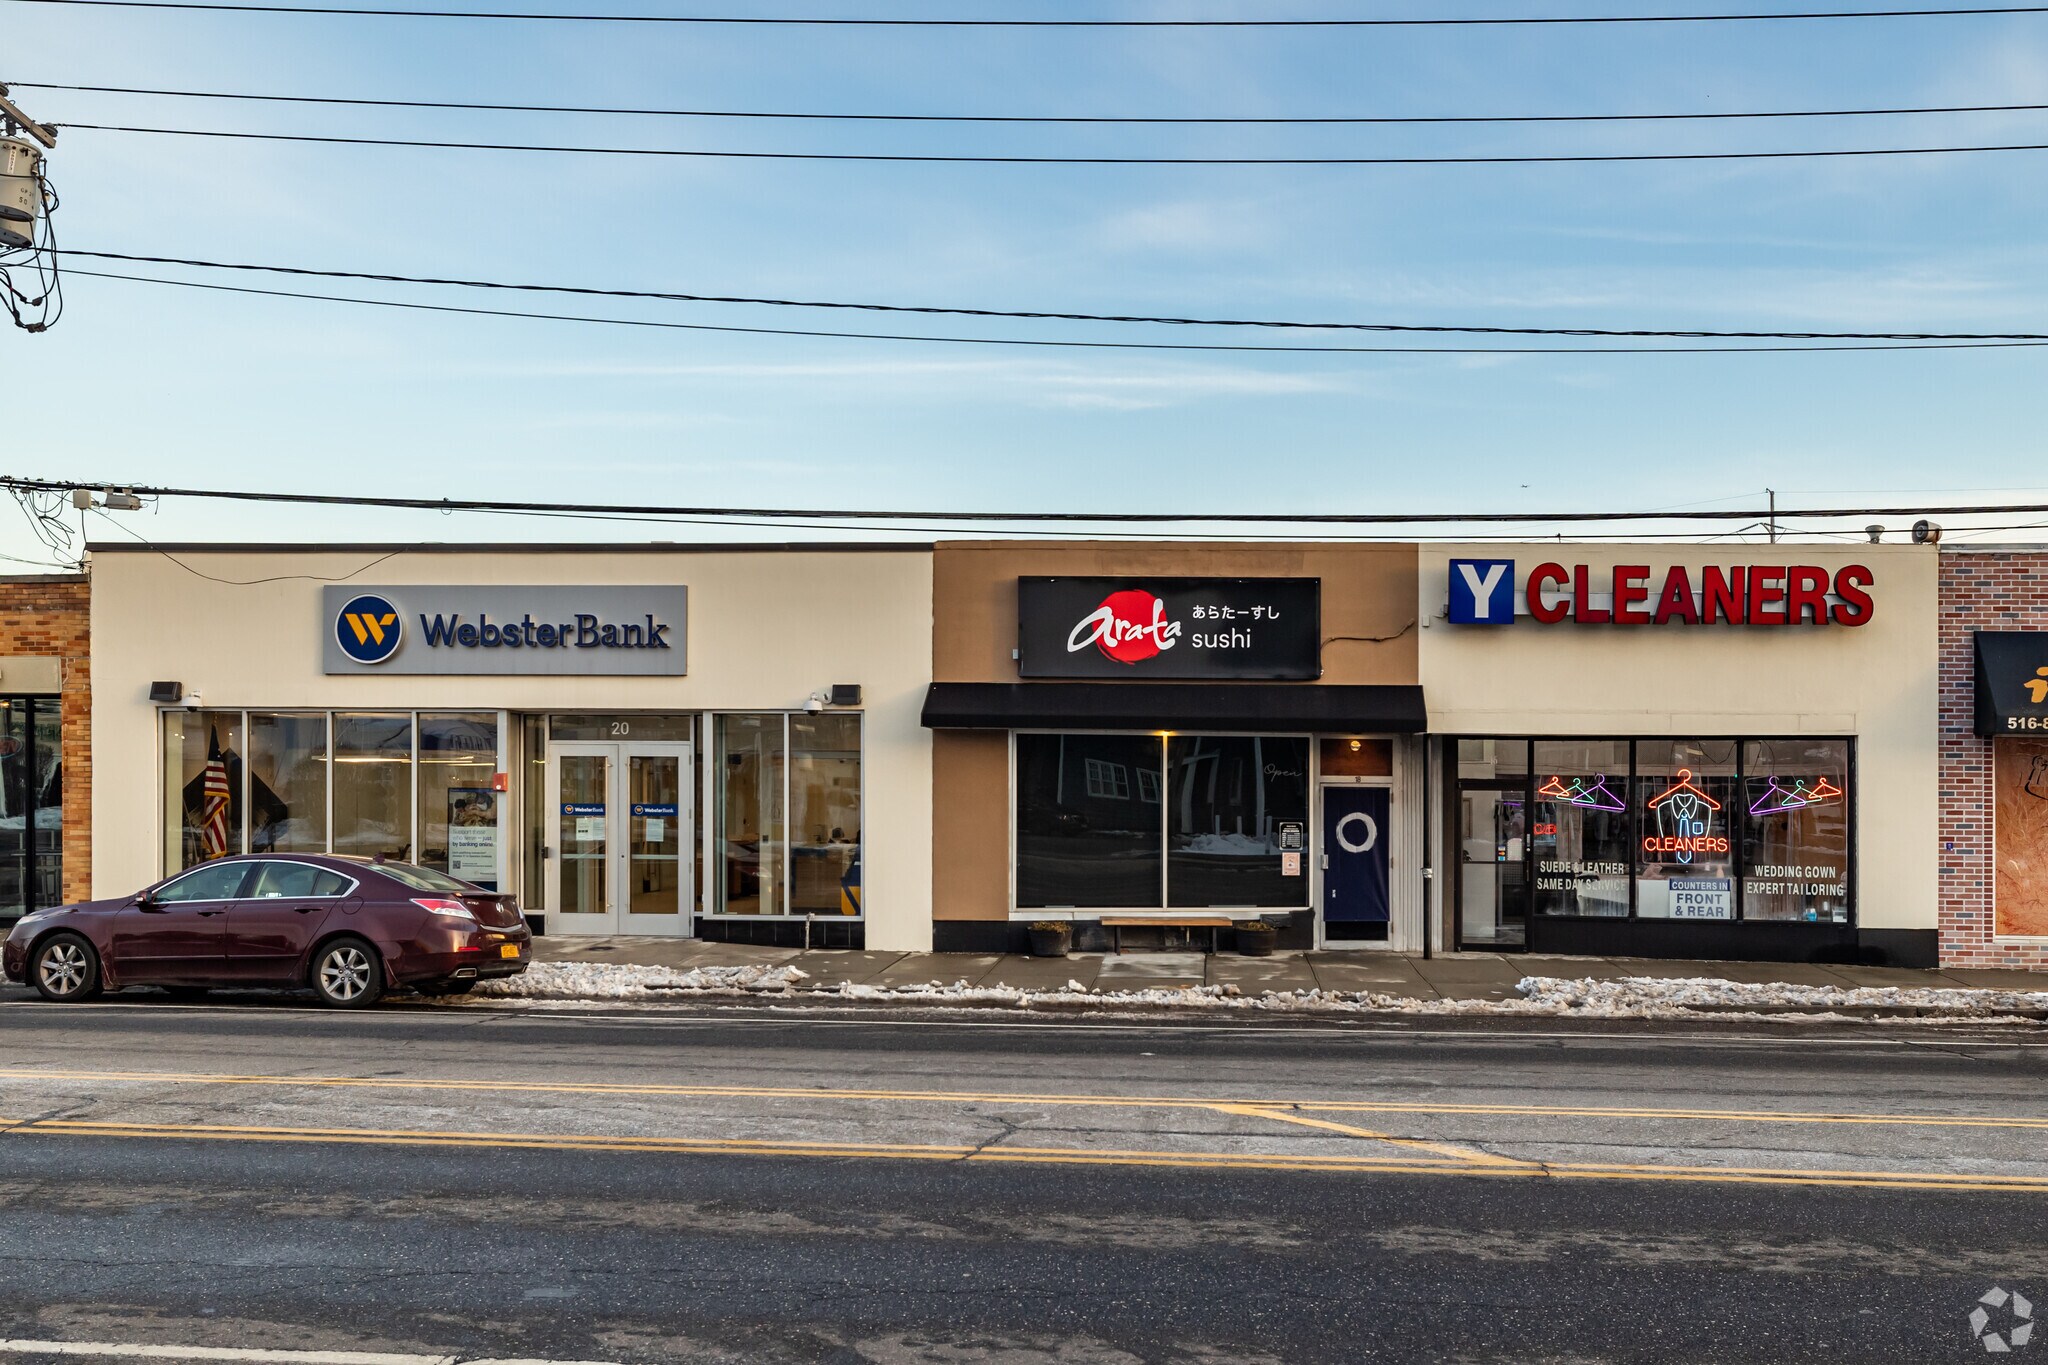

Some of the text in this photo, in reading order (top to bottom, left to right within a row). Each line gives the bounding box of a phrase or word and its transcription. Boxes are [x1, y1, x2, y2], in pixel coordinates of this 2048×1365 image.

[1457, 562, 1875, 627] Y CLEANERS
[1192, 605, 1280, 620] あらたーすし
[419, 613, 671, 649] WebsterBank
[1191, 628, 1251, 649] sushi
[611, 721, 629, 735] 20
[1264, 763, 1302, 782] Open
[1643, 837, 1729, 852] CLEANERS
[1540, 860, 1625, 875] SUEDE & LEATHER
[1754, 865, 1836, 879] WEDDING GOWN
[1537, 878, 1564, 890] SAME
[1565, 878, 1584, 890] DAY
[1671, 881, 1728, 890] COUNTERS IN
[1746, 881, 1845, 897] EXPERT TAILORING
[1676, 893, 1723, 905] FRONT
[1674, 905, 1724, 917] & REAR
